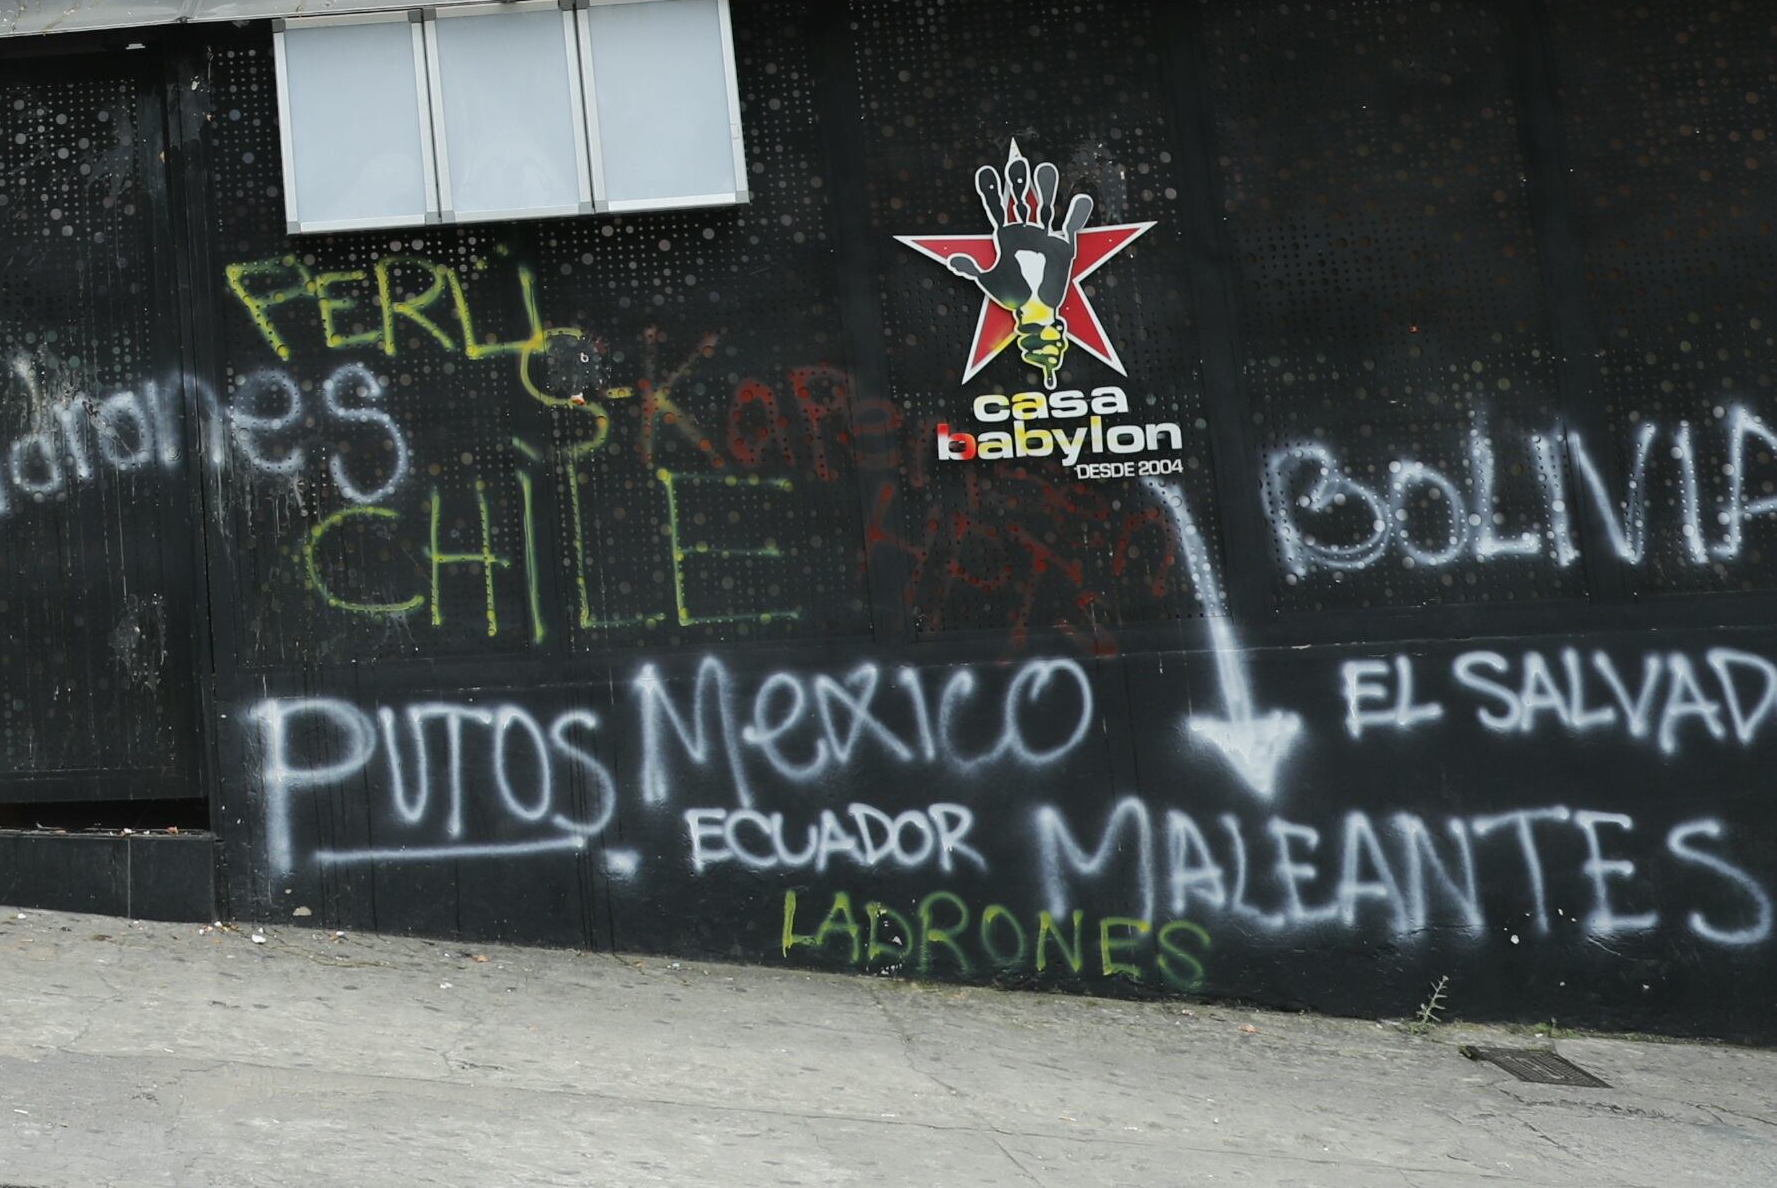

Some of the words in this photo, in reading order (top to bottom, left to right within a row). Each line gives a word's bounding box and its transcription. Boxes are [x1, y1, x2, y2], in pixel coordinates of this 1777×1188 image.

[937, 415, 1183, 467] babylon
[973, 386, 1129, 423] casa
[1076, 461, 1136, 480] DESDE
[1138, 458, 1184, 476] 2004
[305, 438, 802, 642] CHILE
[1341, 653, 1444, 739] EL
[1454, 647, 1777, 754] SALVAD
[685, 803, 987, 873] ECUADOR
[1037, 797, 1774, 947] MALEANTES
[781, 890, 1211, 991] LADRONES
